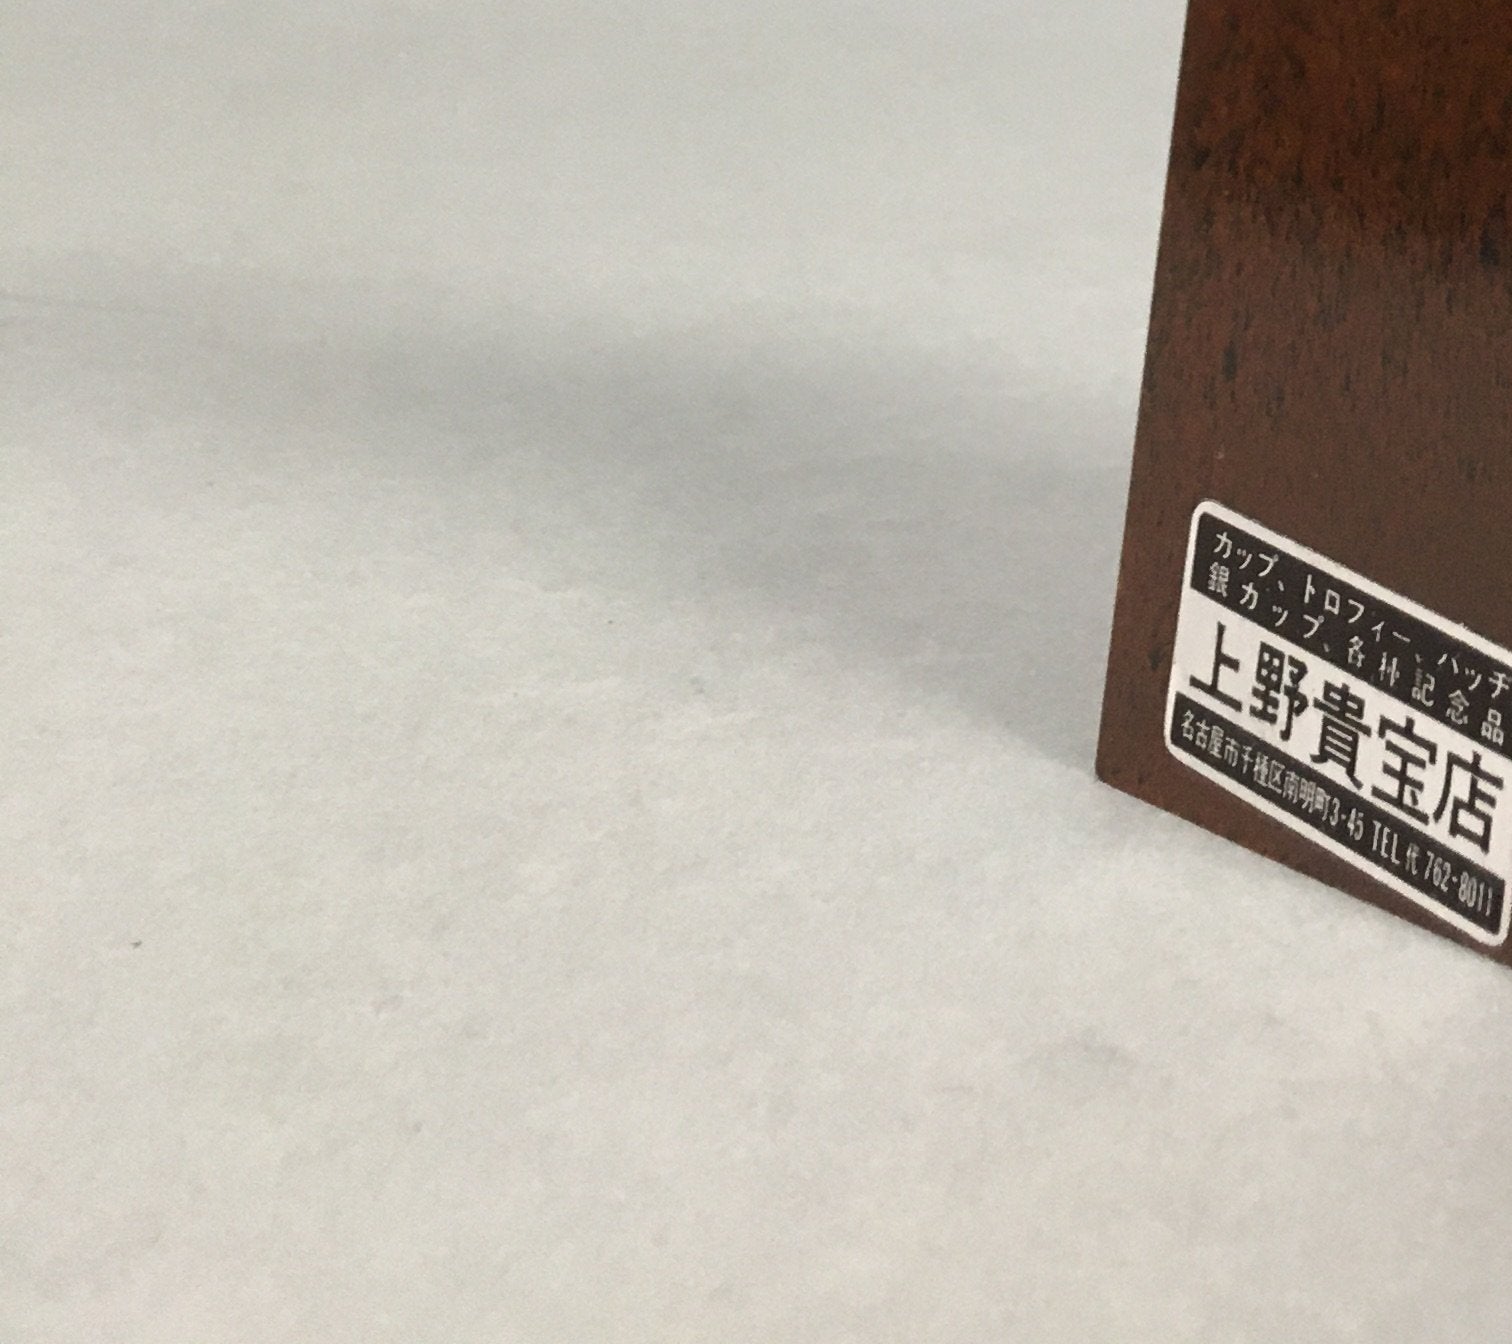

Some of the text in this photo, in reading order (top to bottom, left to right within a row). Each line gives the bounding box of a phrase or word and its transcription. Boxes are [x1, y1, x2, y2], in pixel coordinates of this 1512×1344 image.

[1189, 620, 1504, 855] 上野貴宝店
[1371, 819, 1401, 865] TEL
